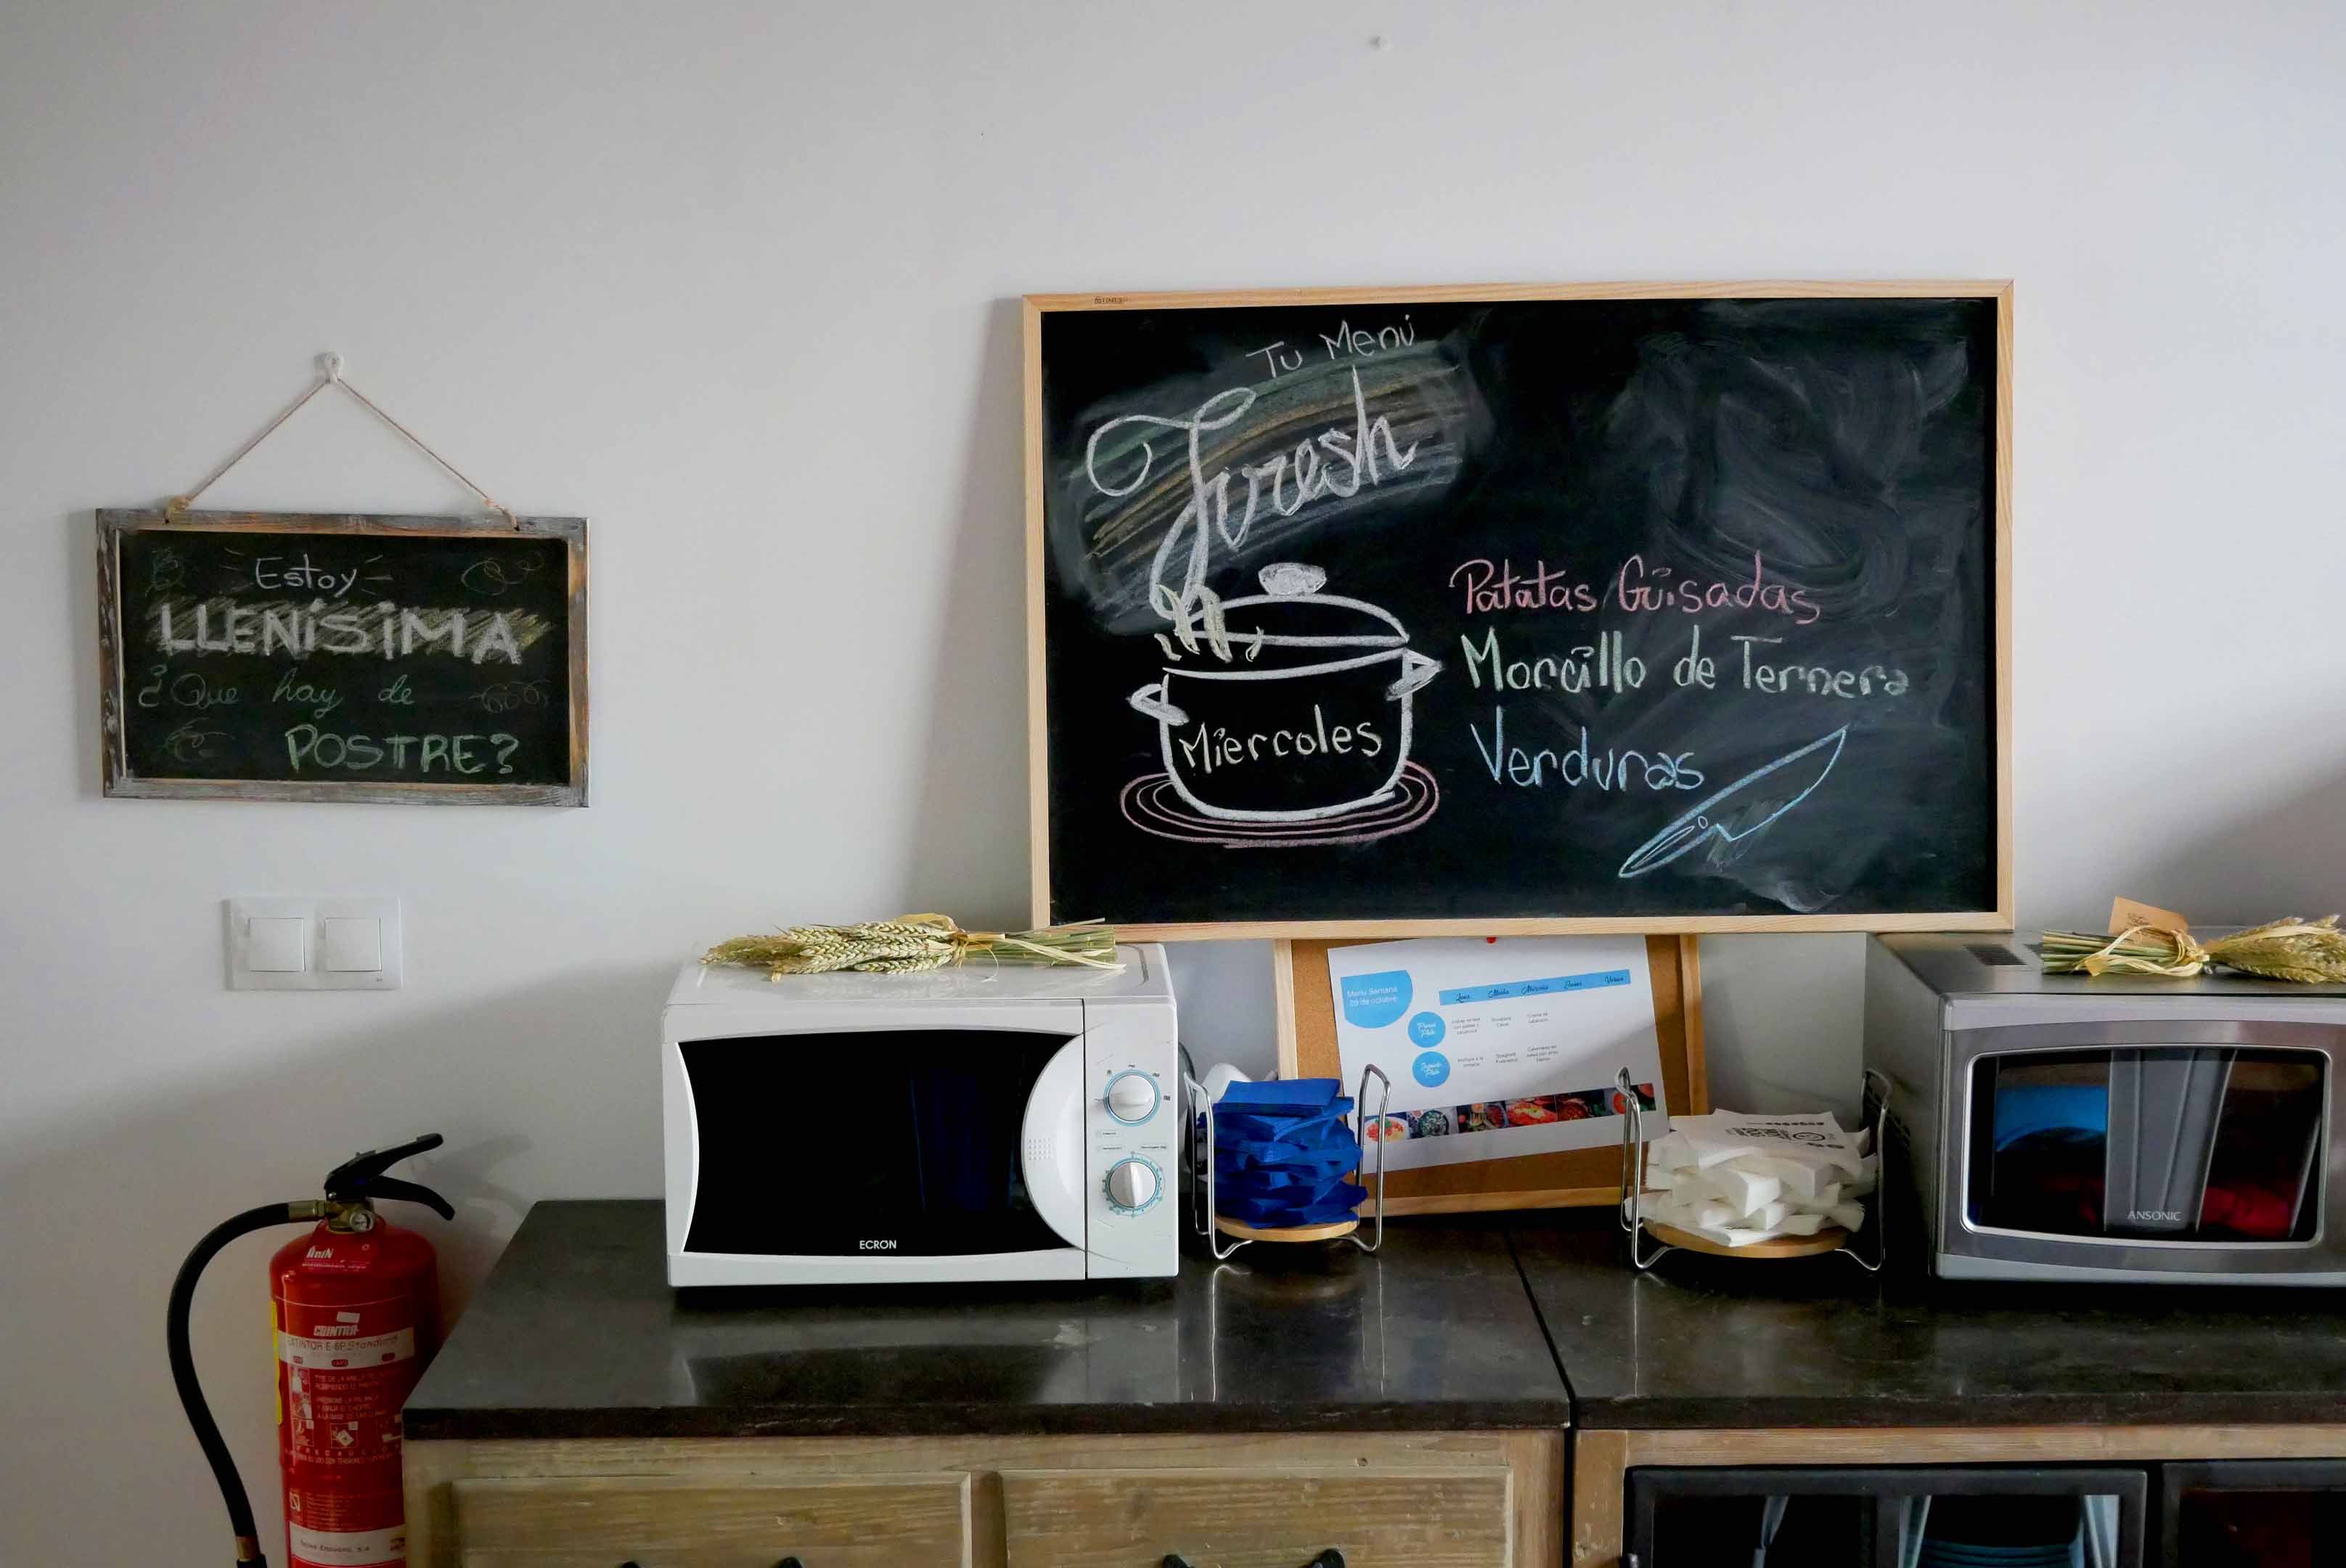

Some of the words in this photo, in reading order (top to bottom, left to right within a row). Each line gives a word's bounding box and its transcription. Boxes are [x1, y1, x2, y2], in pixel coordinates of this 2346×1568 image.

[1246, 341, 1302, 377] Tu
[1087, 364, 1419, 621] Fresh
[256, 553, 356, 597] Estoy
[1449, 558, 1596, 614] Patatas
[1619, 550, 1820, 624] Guisadas
[1460, 626, 1646, 693] Morcillo
[1674, 625, 1714, 688] de
[1730, 635, 1908, 698] Ternera
[272, 667, 342, 719] hay
[377, 674, 414, 703] de
[285, 724, 518, 773] POSTRE?
[1179, 705, 1383, 774] Miercoles
[1471, 706, 1704, 791] Verduras
[2128, 1211, 2181, 1221] ANSONIC
[859, 1240, 896, 1249] ECRON
